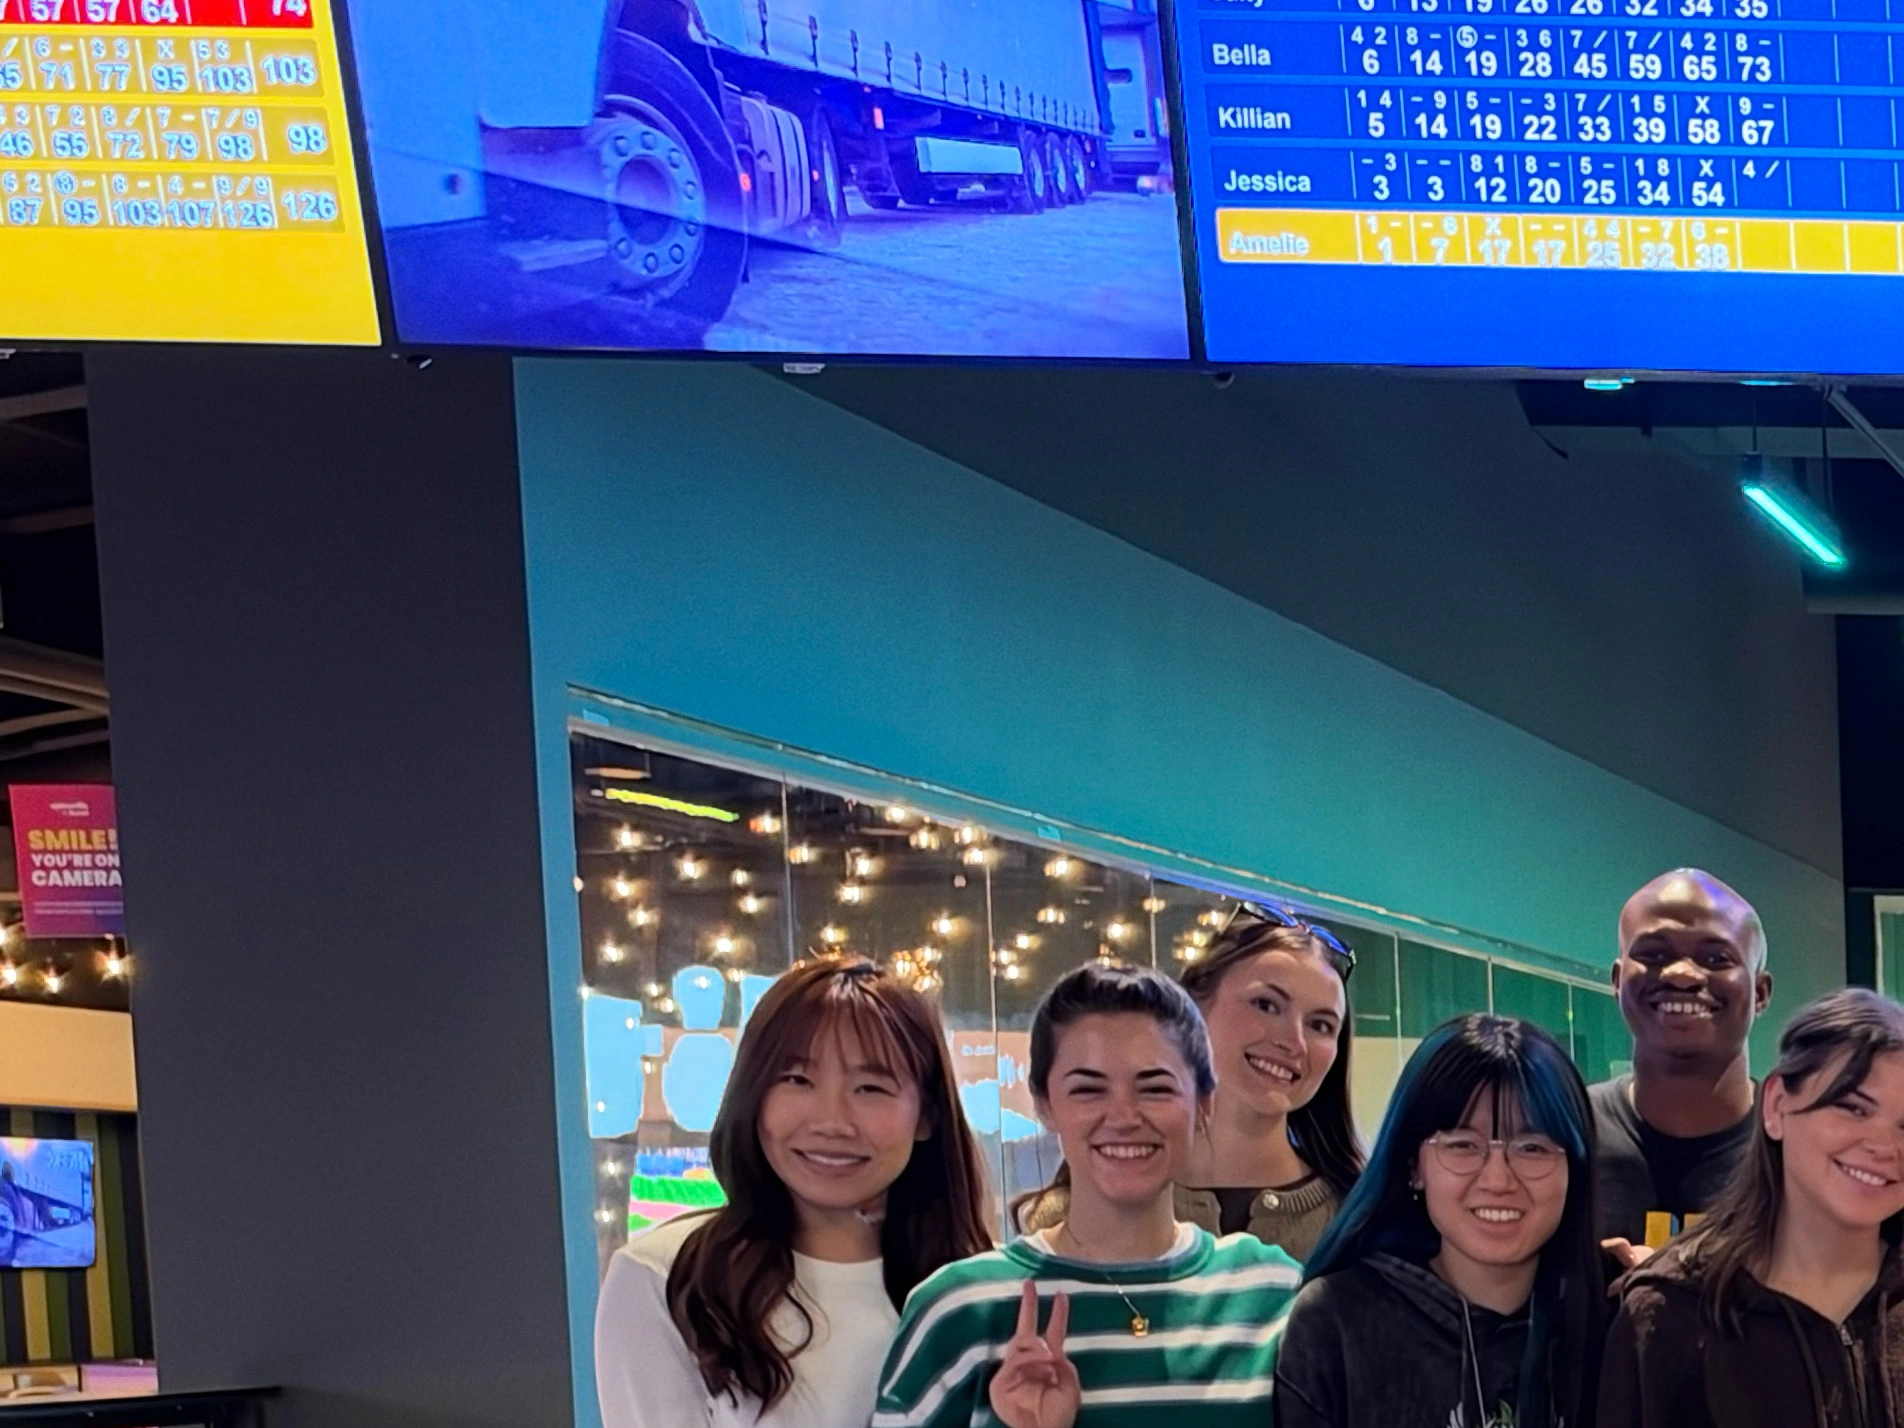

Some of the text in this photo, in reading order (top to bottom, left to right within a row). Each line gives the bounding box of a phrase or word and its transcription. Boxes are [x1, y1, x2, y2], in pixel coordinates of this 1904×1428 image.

[39, 56, 316, 92] 71 77 95 103 103
[1213, 44, 1271, 65] Bella
[1363, 49, 1379, 74] 6
[1410, 50, 1443, 74] 14
[1465, 51, 1497, 76] 19
[1519, 52, 1552, 77] 28
[1574, 53, 1607, 78] 45
[1630, 54, 1661, 79] 59
[1684, 55, 1716, 80] 65
[1738, 56, 1771, 82] 73
[287, 125, 326, 152] 98
[1219, 107, 1290, 128] Killian
[1369, 112, 1384, 137] 5
[1415, 113, 1447, 138] 14
[1470, 114, 1501, 139] 19
[1524, 115, 1557, 140] 22
[1579, 116, 1611, 141] 33
[1634, 117, 1665, 142] 39
[1688, 119, 1720, 144] 58
[1742, 120, 1774, 144] 67
[1224, 170, 1311, 192] Jessica
[1373, 175, 1389, 200] 3
[1428, 176, 1444, 200] 3
[1475, 177, 1506, 202] 12
[1528, 178, 1560, 203] 20
[1583, 179, 1616, 204] 25
[1638, 180, 1670, 205] 34
[1692, 182, 1724, 206] 54
[282, 192, 337, 220] 126
[1229, 231, 1310, 257] Amelie
[28, 828, 118, 850] SMILE!
[31, 854, 120, 868] YOU'RE ON
[32, 870, 123, 887] CAMERA
